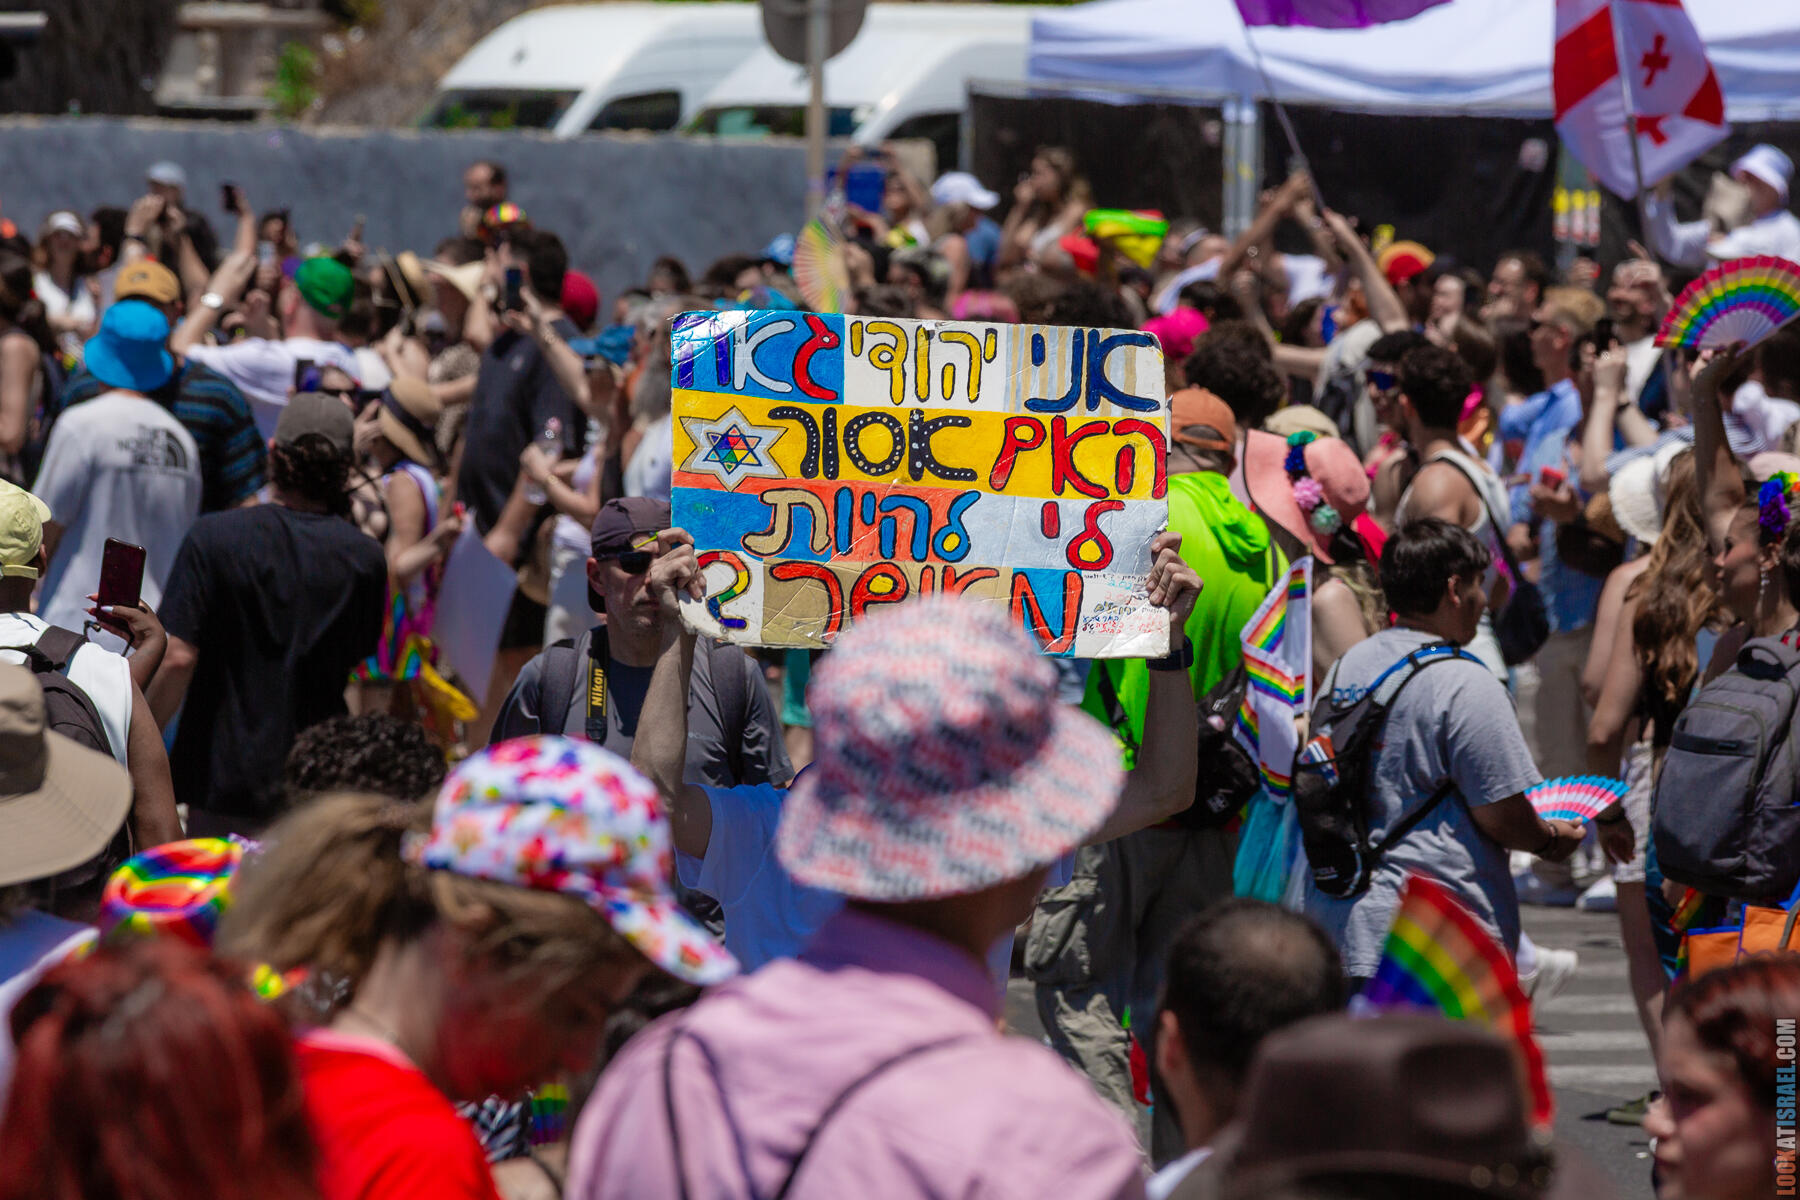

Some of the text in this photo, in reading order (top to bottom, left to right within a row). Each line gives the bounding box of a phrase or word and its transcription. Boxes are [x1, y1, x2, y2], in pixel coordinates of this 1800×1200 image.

[672, 312, 1161, 412] אני יהודי גאה
[768, 409, 978, 482] אסור
[742, 487, 1125, 570] לי להיות
[591, 668, 604, 707] Nikon
